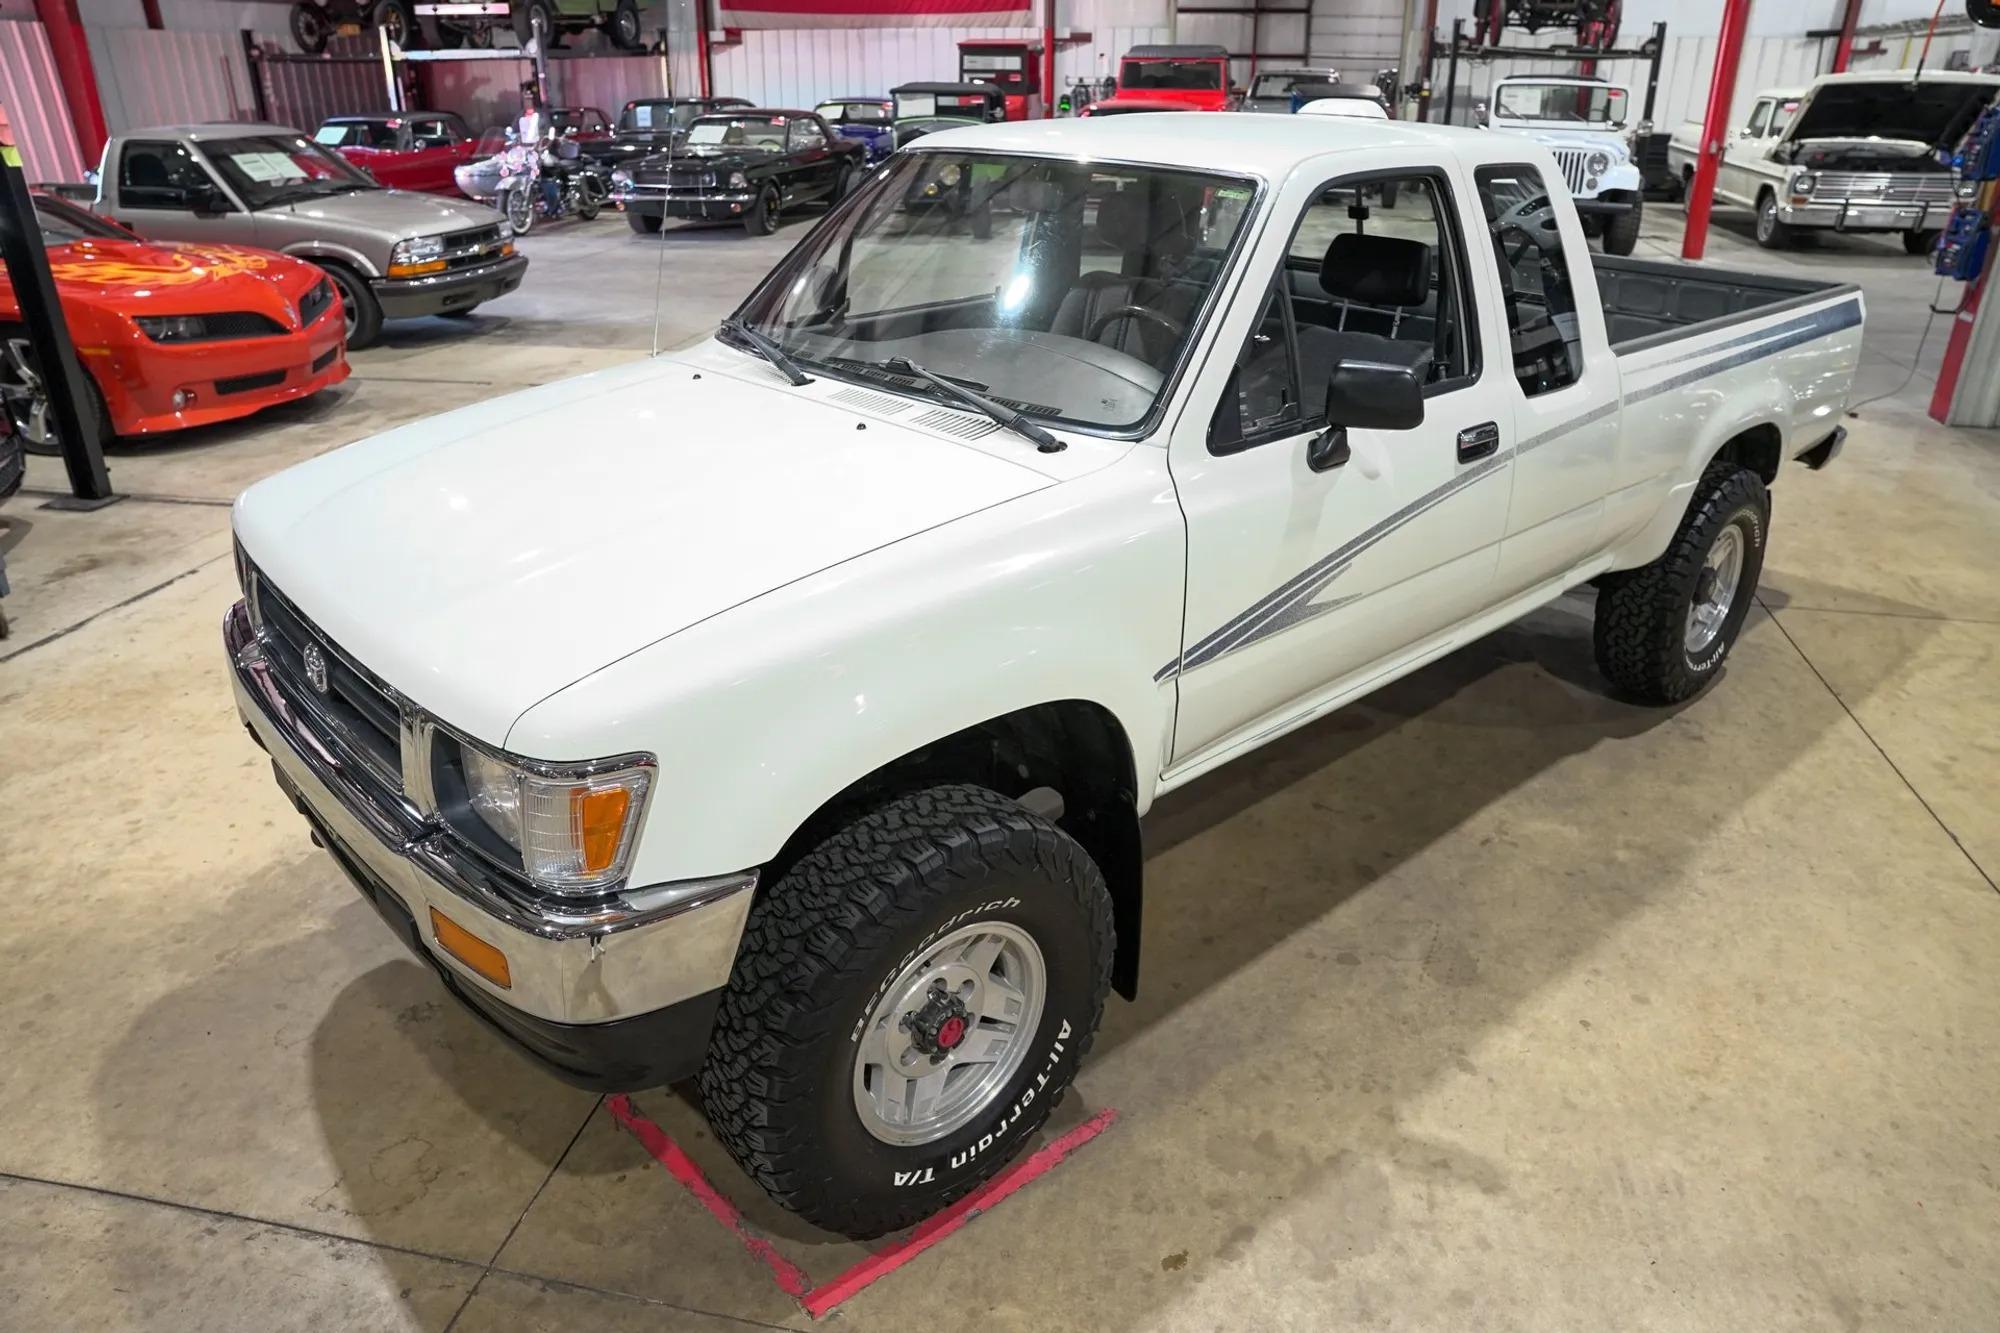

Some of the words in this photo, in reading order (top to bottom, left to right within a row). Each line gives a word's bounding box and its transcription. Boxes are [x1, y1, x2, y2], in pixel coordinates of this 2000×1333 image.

[851, 897, 1021, 1042] BFGoodrich
[951, 1018, 1072, 1169] All-Terrain
[893, 1167, 936, 1187] T/A
